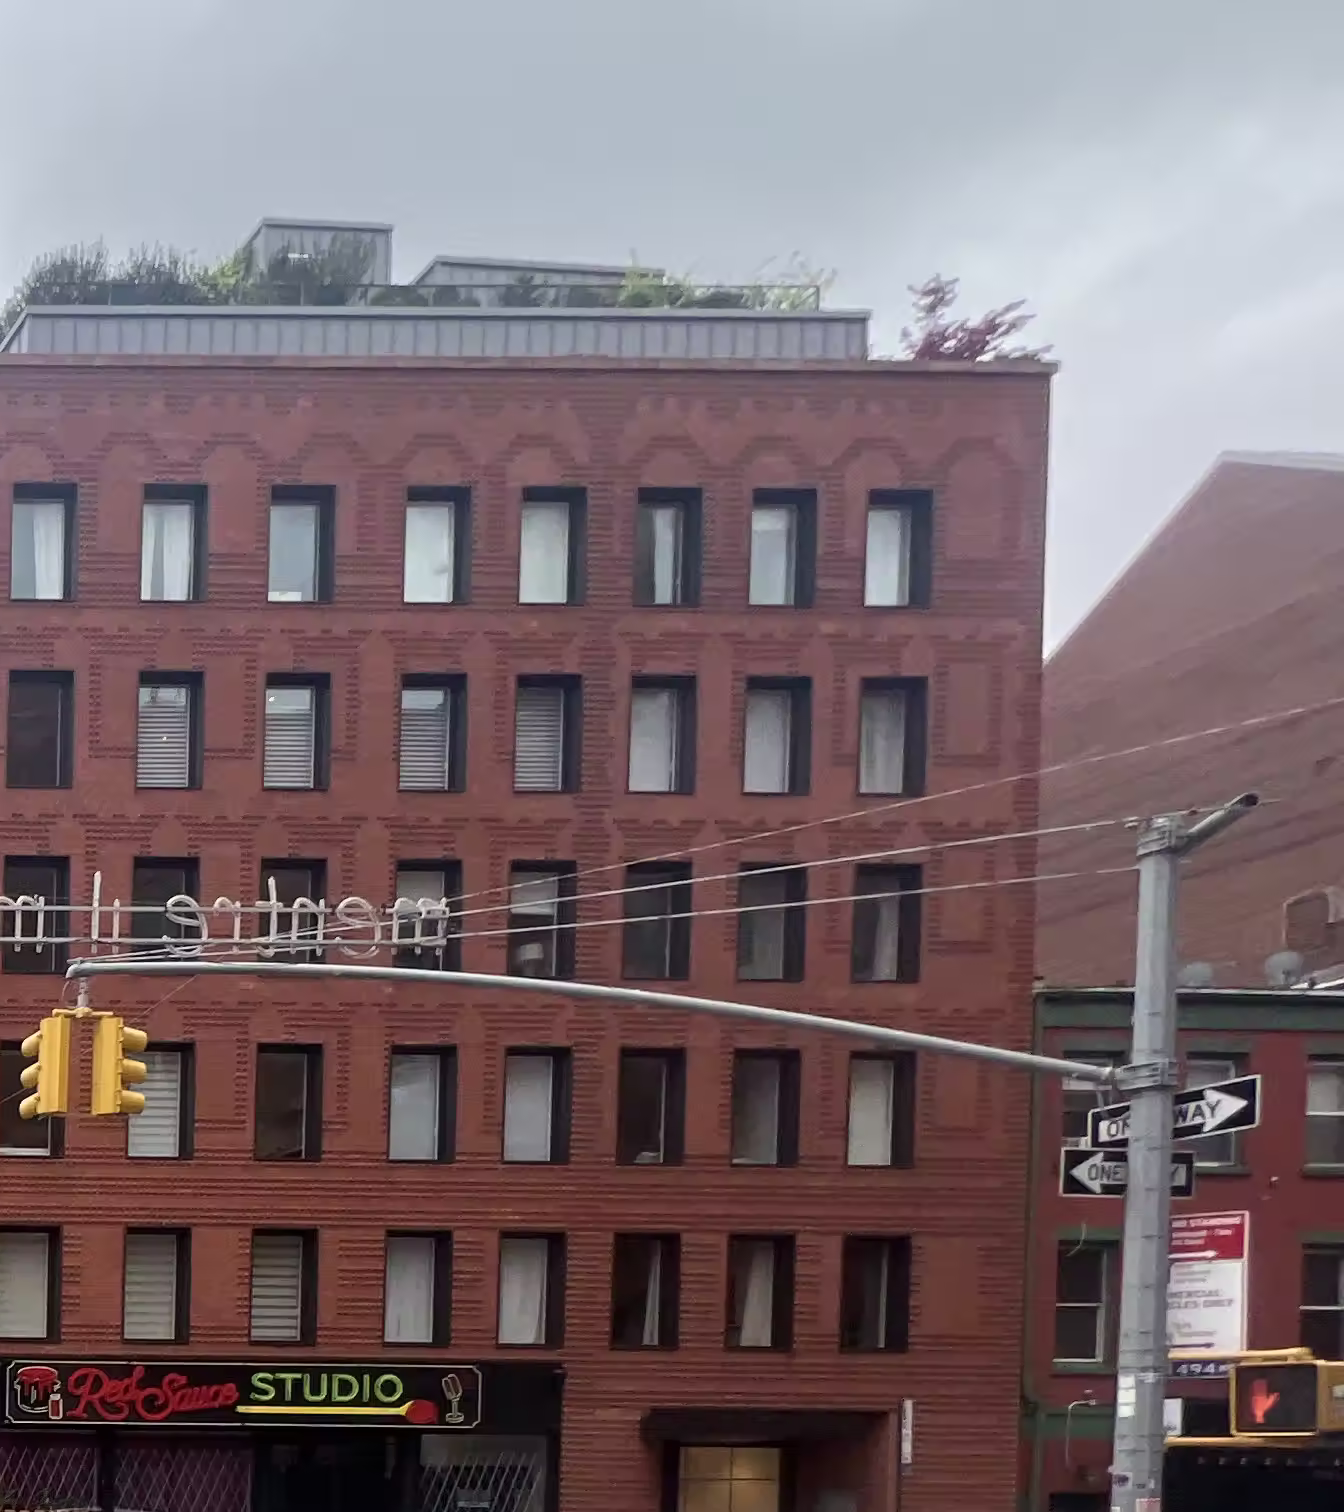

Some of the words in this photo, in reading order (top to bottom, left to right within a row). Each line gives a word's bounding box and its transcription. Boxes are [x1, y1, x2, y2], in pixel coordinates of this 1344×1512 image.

[1087, 1163, 1125, 1182] ONE
[67, 1366, 145, 1420] Red
[136, 1373, 240, 1421] Sauce
[249, 1372, 404, 1403] STUDIO
